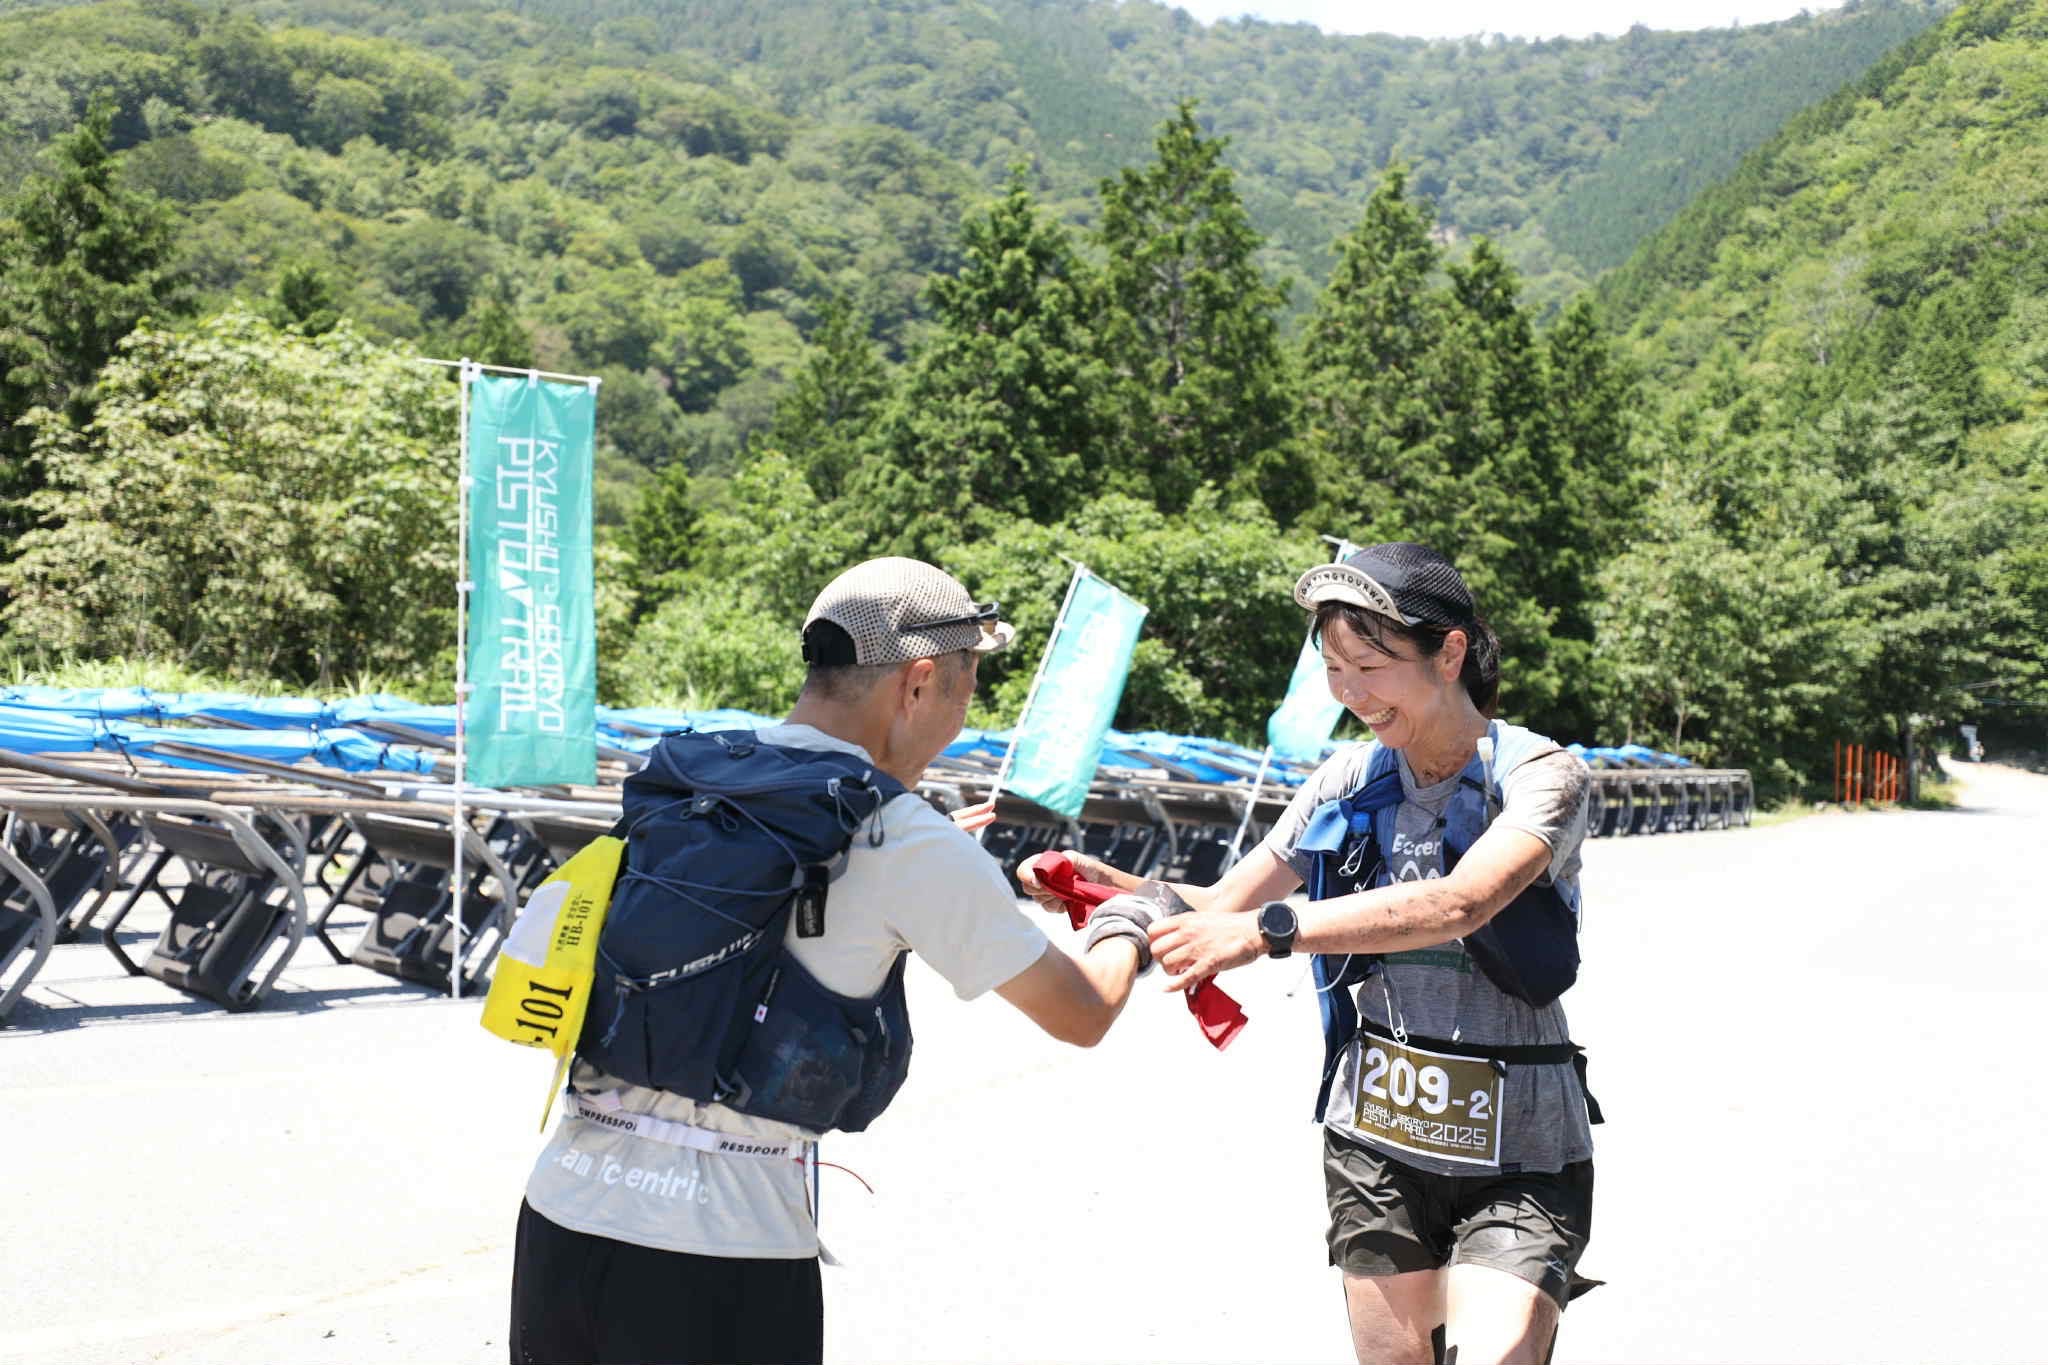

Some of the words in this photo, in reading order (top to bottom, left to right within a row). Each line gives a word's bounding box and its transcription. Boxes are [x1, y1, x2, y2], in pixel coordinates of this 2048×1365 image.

[535, 440, 560, 573] KYUSHU
[500, 608, 537, 732] TRAIL
[535, 603, 564, 733] SEKIRYO
[566, 898, 595, 947] HB-101
[512, 980, 573, 1047] -101
[1362, 1048, 1489, 1120] 209-2
[1430, 1122, 1488, 1147] 2025
